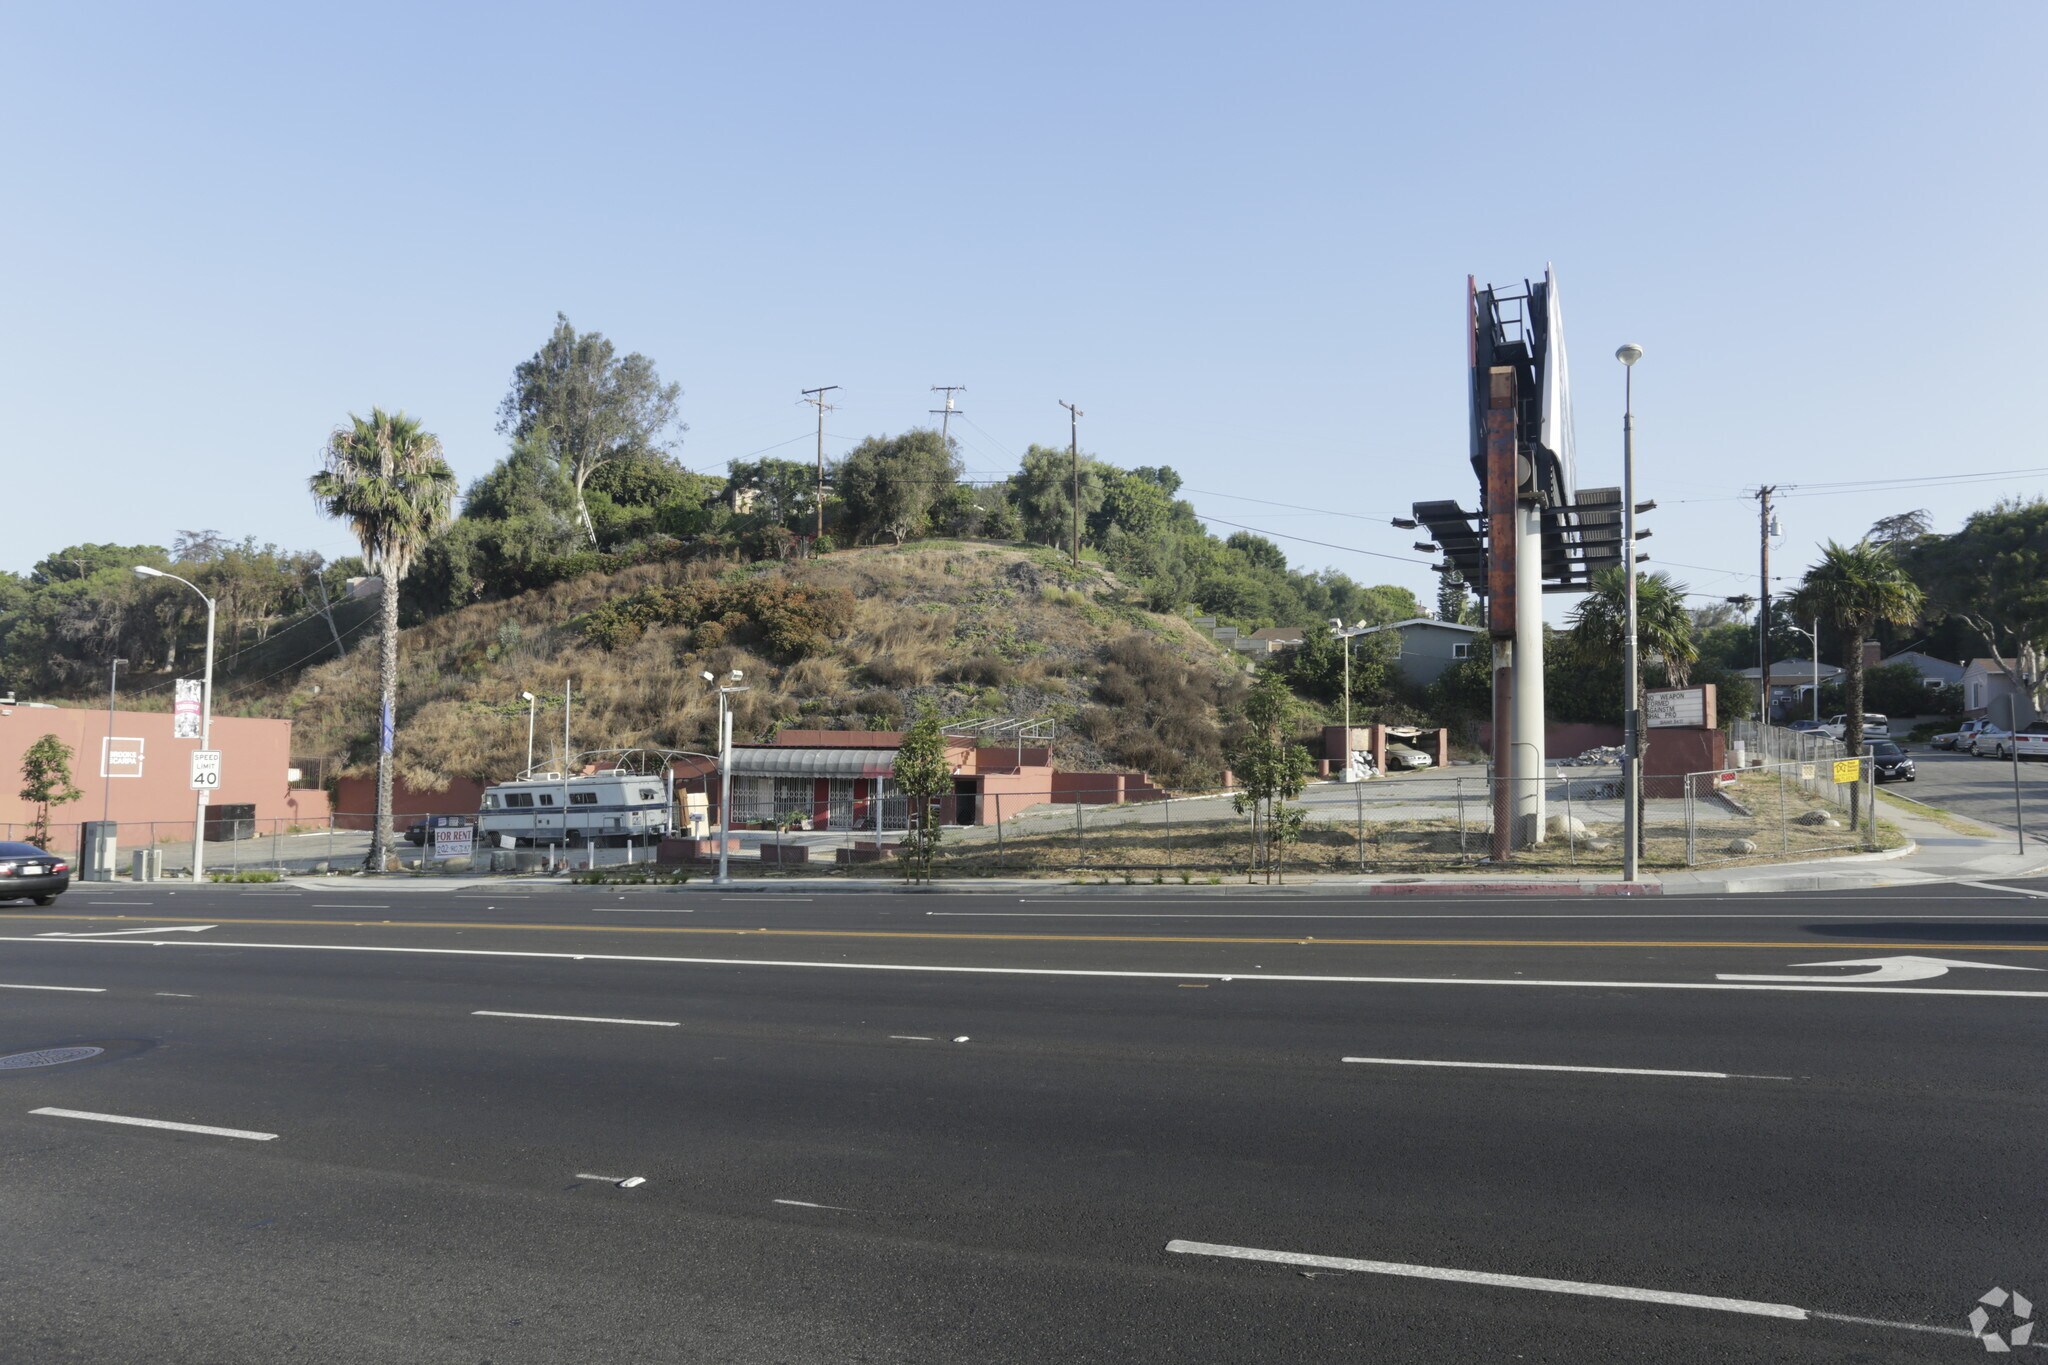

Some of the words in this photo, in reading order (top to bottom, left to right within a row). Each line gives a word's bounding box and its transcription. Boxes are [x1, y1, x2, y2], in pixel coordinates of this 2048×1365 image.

[194, 772, 216, 784] 40
[437, 831, 451, 840] FOR
[454, 831, 471, 840] RENT
